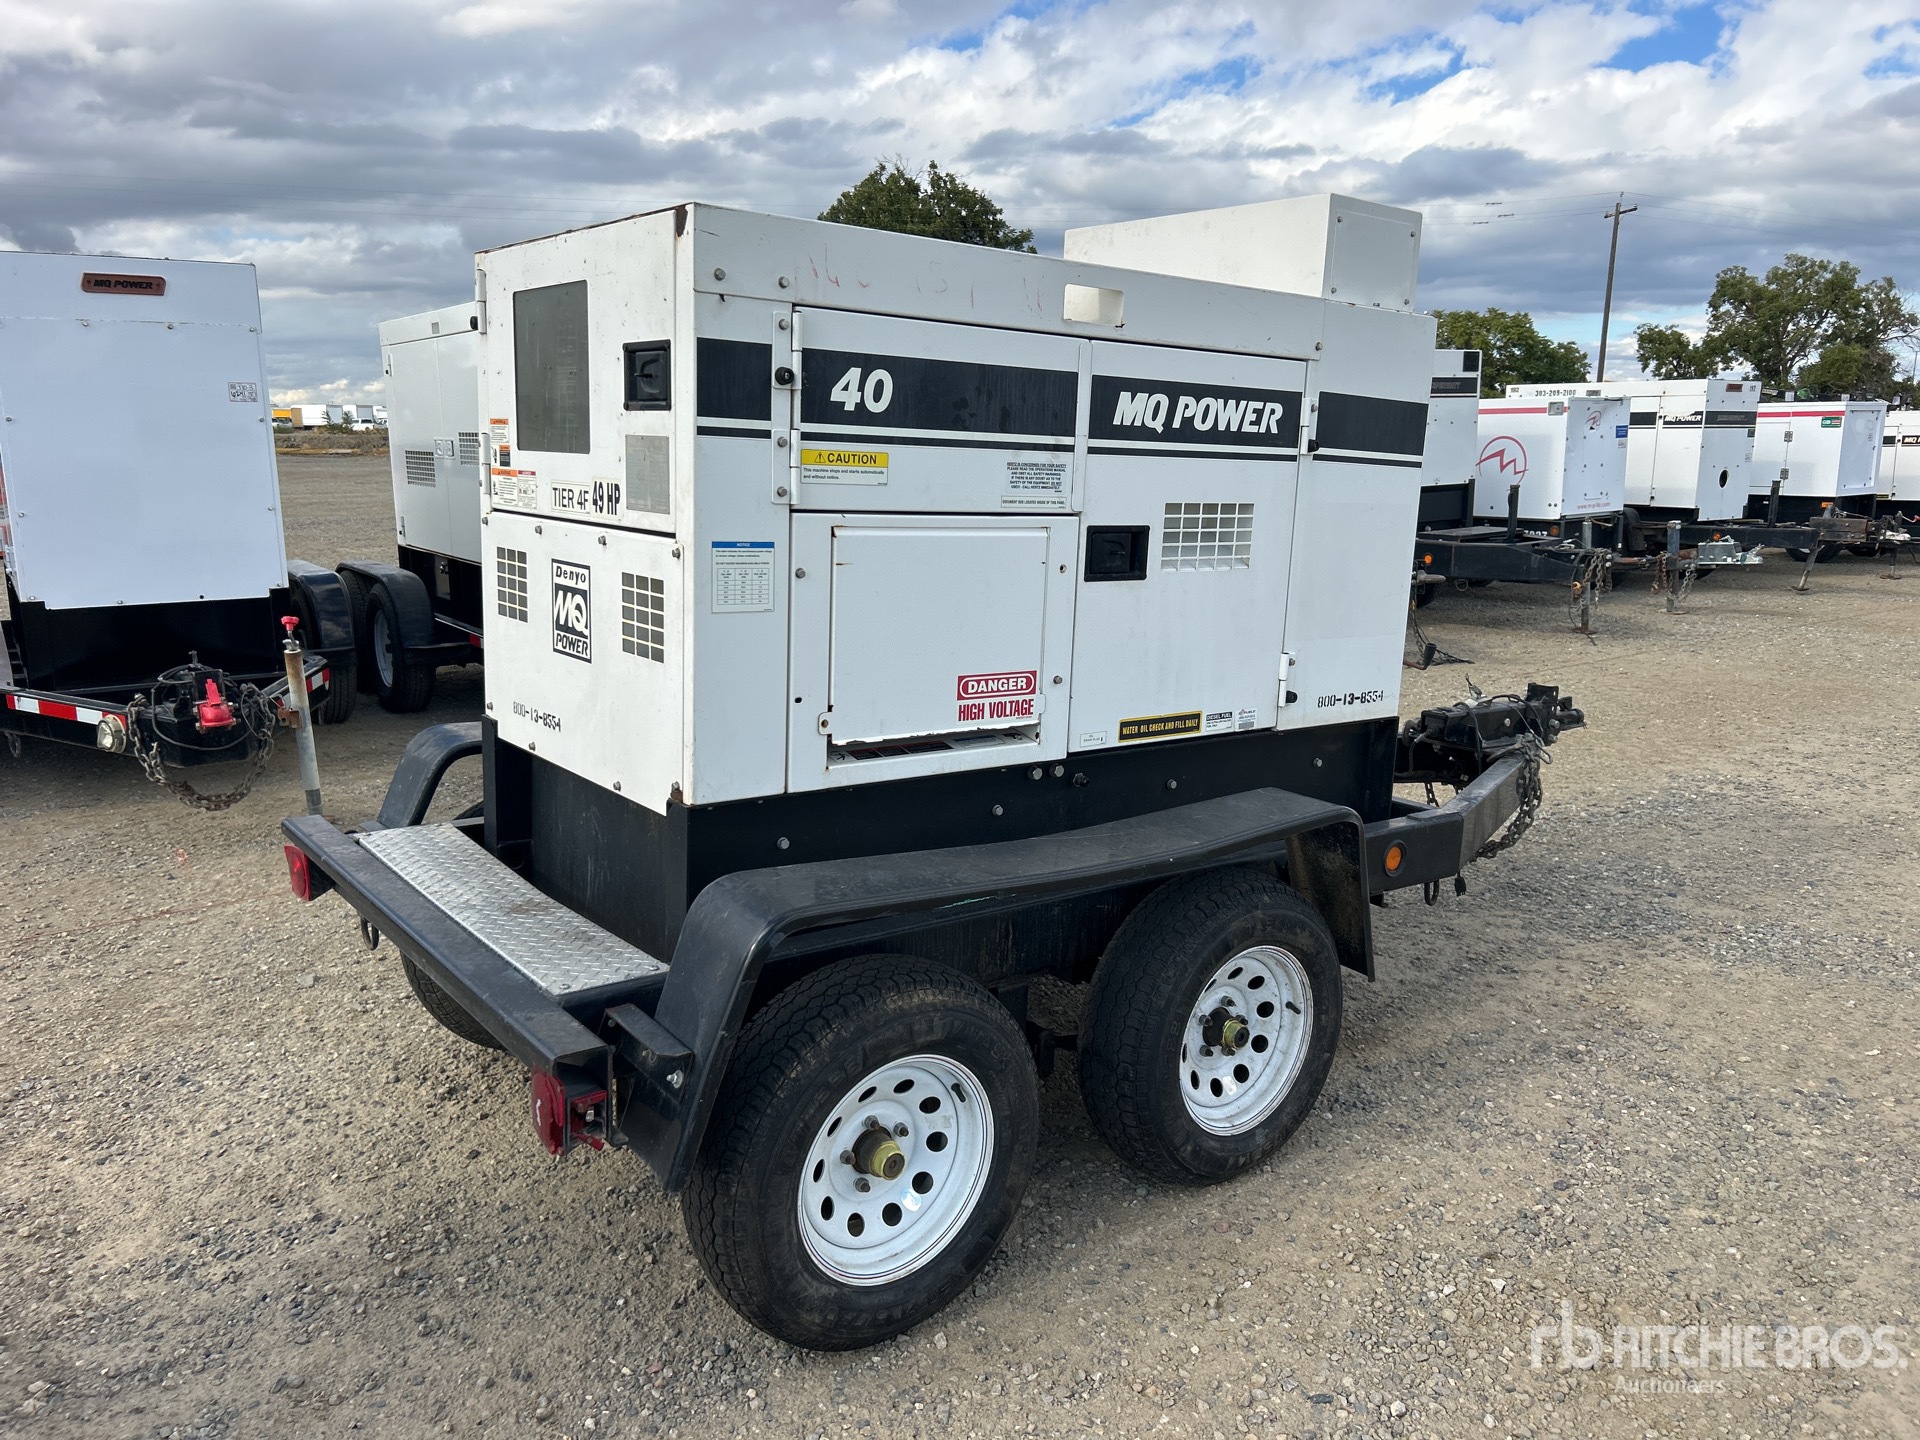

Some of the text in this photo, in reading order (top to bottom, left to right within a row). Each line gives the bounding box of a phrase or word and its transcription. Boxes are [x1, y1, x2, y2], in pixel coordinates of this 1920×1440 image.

[93, 279, 153, 290] MQ POWER
[830, 367, 894, 413] 40
[1113, 391, 1284, 434] MQ POWER
[1676, 413, 1703, 422] POWER
[1903, 436, 1918, 444] MQ
[827, 453, 877, 465] CAUTION
[552, 487, 575, 509] TIER
[577, 489, 589, 510] 4F
[592, 480, 604, 514] 49
[606, 482, 621, 516] HP
[555, 565, 586, 585] Denyo
[554, 590, 589, 636] MQ
[556, 632, 588, 656] POWER
[967, 677, 1027, 694] DANGER
[958, 698, 1034, 721] HIGH VOLTAGE
[1122, 725, 1139, 735] WATER
[1140, 724, 1149, 733] OIL
[1149, 722, 1165, 732] CHECK
[1165, 721, 1175, 730] AND
[1174, 719, 1186, 729] FILL
[1185, 718, 1199, 728] DAILY
